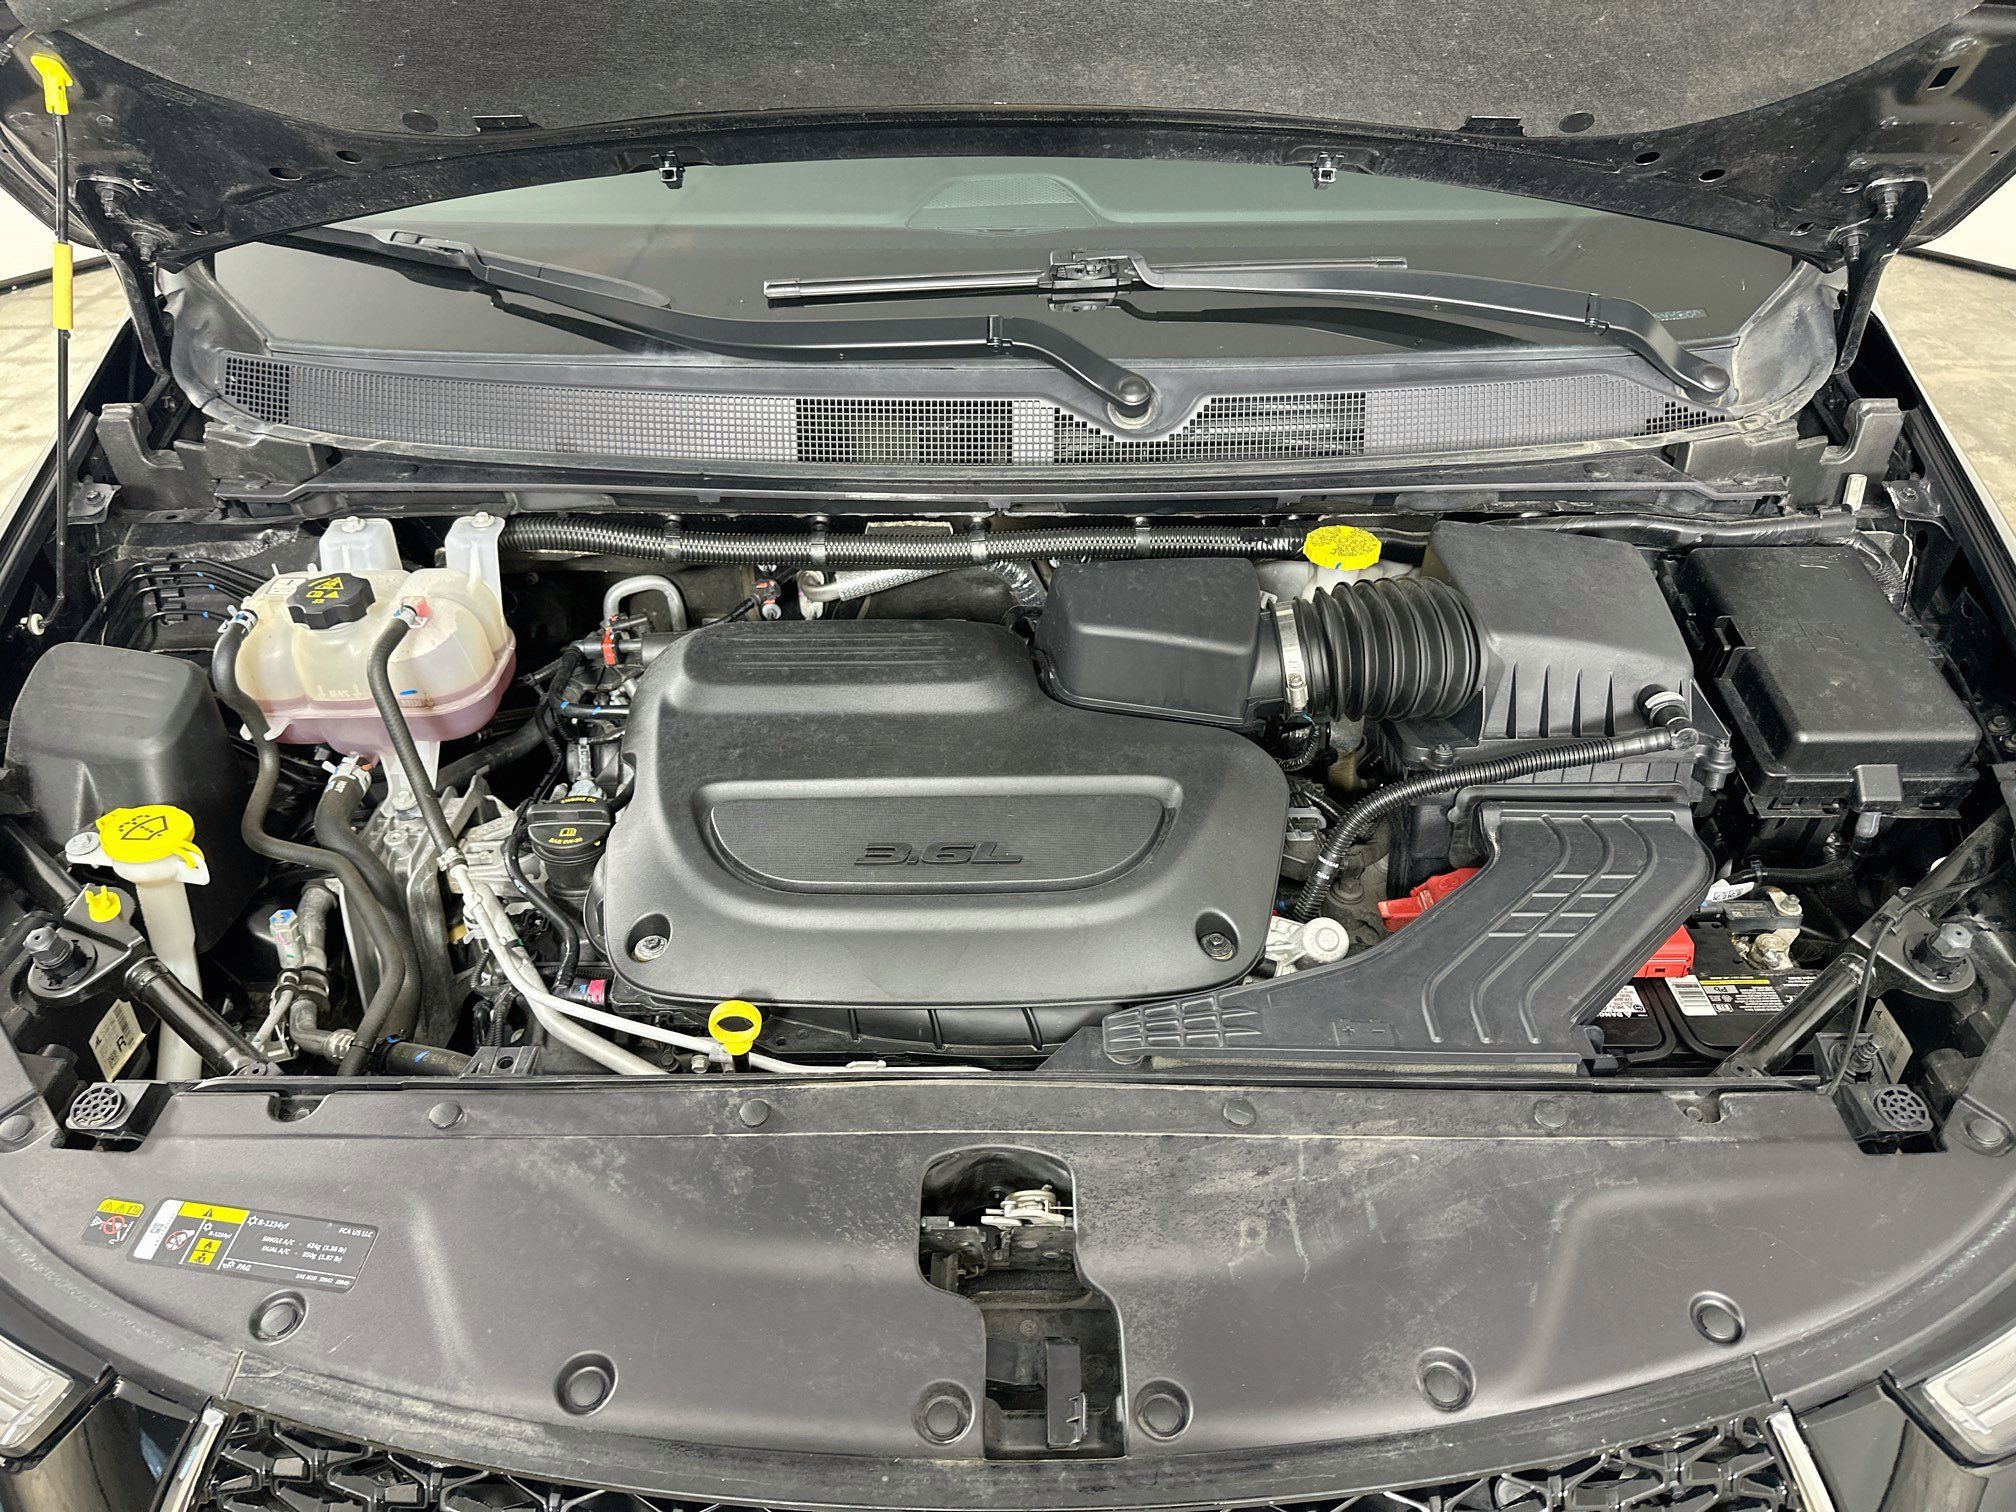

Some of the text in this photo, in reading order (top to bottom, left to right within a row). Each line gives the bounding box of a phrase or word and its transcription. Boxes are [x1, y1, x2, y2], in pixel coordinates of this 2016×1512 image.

[853, 841, 1023, 865] 3.6L
[116, 1035, 127, 1052] R
[257, 1220, 290, 1230] R-1234yf
[338, 1227, 374, 1238] FCA US LLC
[261, 1235, 282, 1244] SINGLE
[282, 1237, 295, 1246] A/C
[261, 1245, 279, 1254] DUAL
[279, 1247, 291, 1256] A/C
[236, 1263, 252, 1272] PAG
